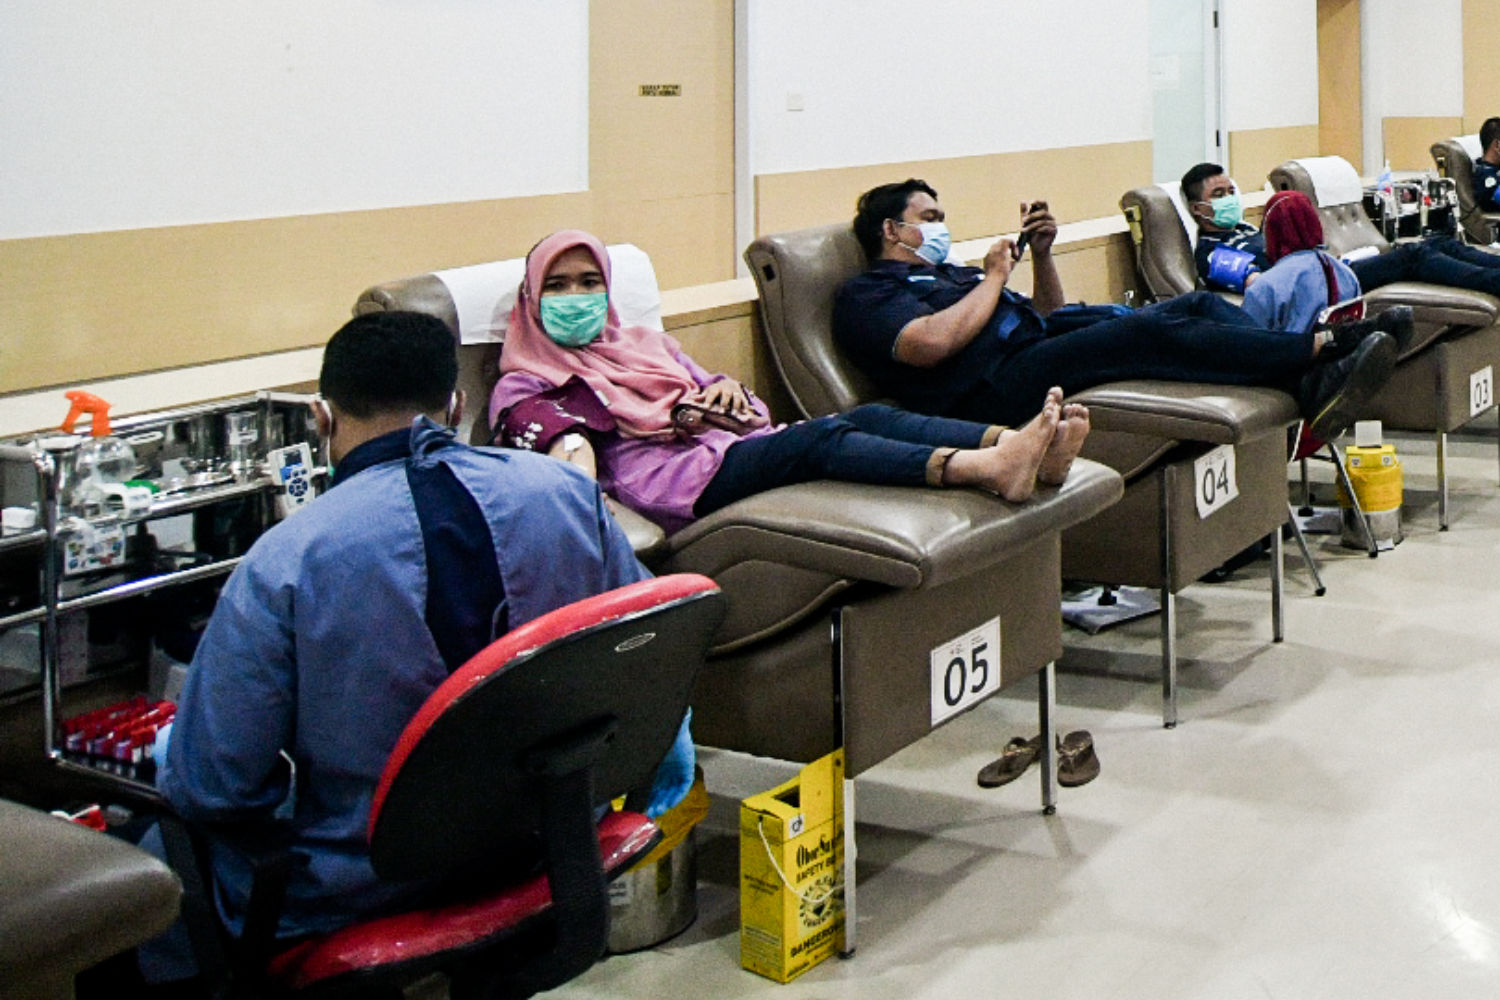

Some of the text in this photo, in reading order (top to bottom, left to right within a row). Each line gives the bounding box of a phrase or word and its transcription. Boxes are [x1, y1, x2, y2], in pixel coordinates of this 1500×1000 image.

[1474, 378, 1489, 409] 03
[1203, 458, 1228, 506] 04
[944, 641, 989, 707] 05
